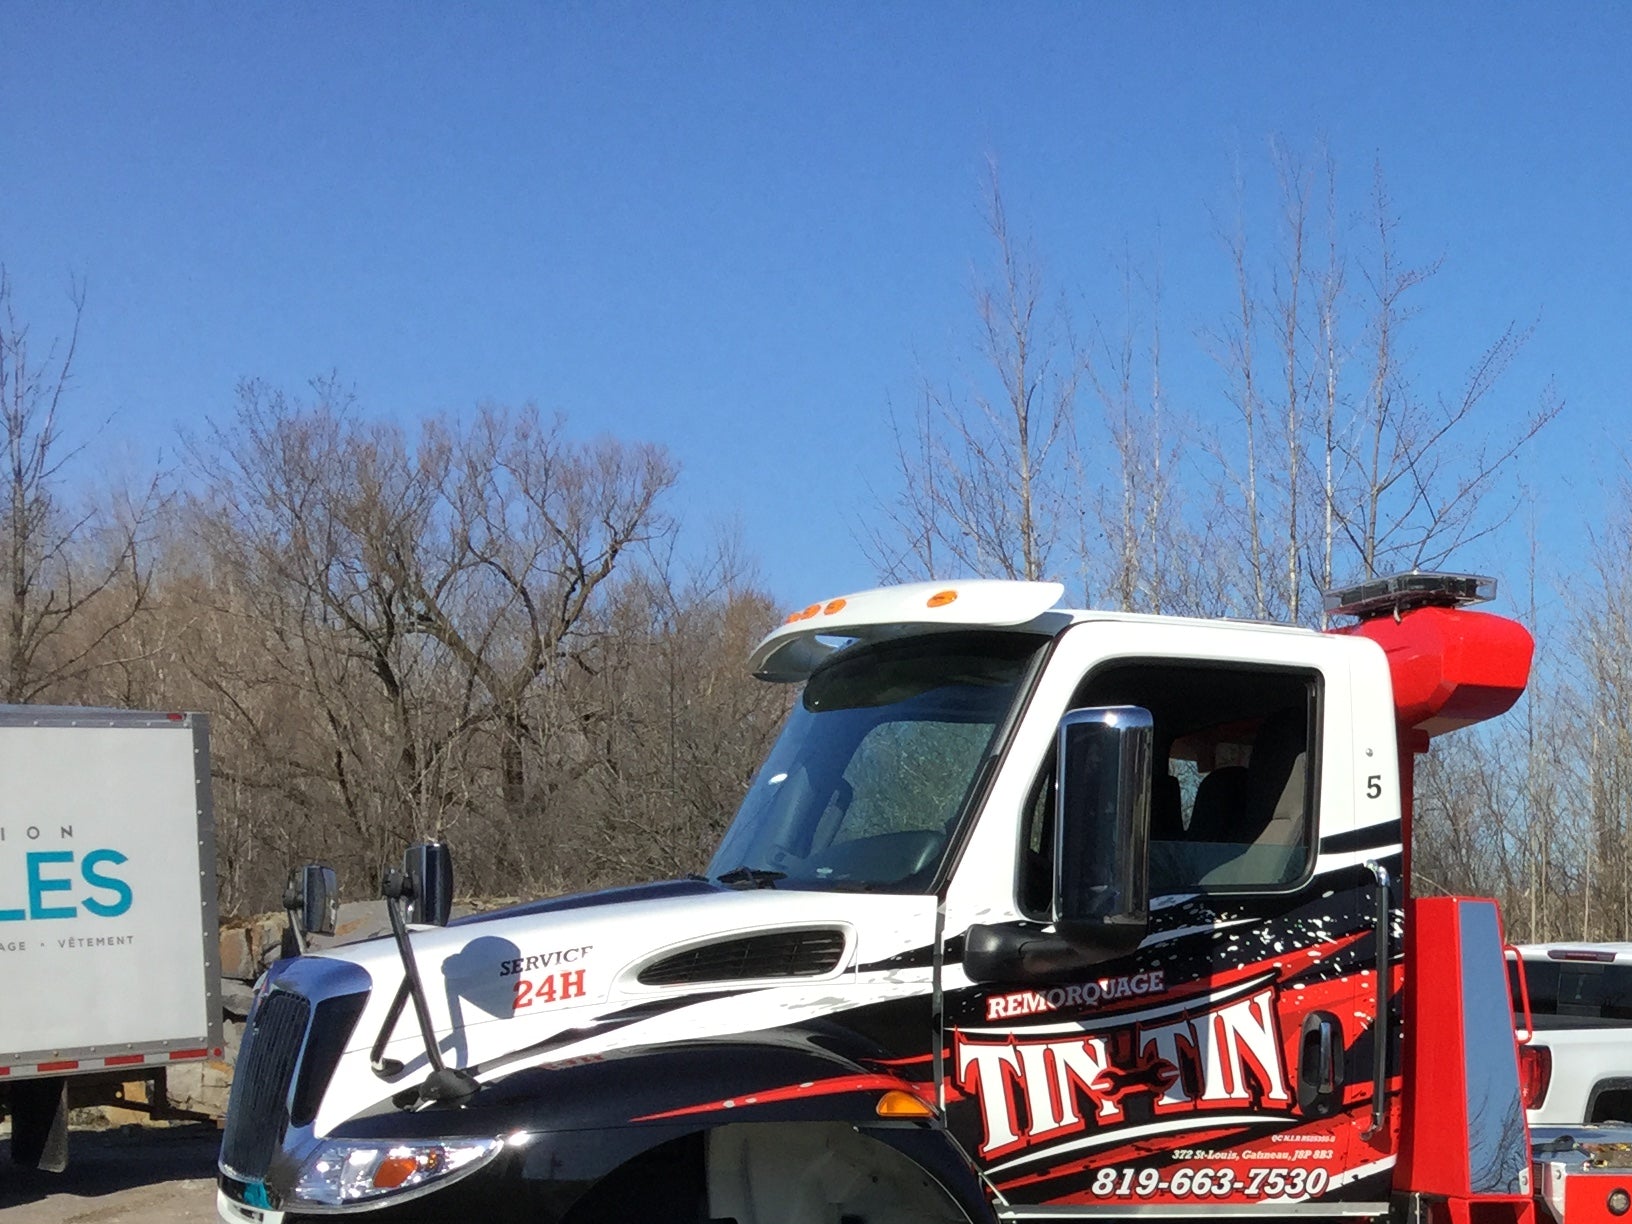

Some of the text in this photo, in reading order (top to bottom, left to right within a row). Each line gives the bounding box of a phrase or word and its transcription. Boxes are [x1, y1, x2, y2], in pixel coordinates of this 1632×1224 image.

[1366, 774, 1382, 799] 5
[57, 935, 134, 949] VÊTEMENT
[512, 969, 586, 1010] 24H
[987, 970, 1165, 1020] REMORQUAGE
[1172, 1150, 1193, 1160] 372
[1194, 1150, 1240, 1161] St-Louis,
[1242, 1150, 1293, 1161] Gatineau,
[1091, 1167, 1329, 1198] 819-663-7530
